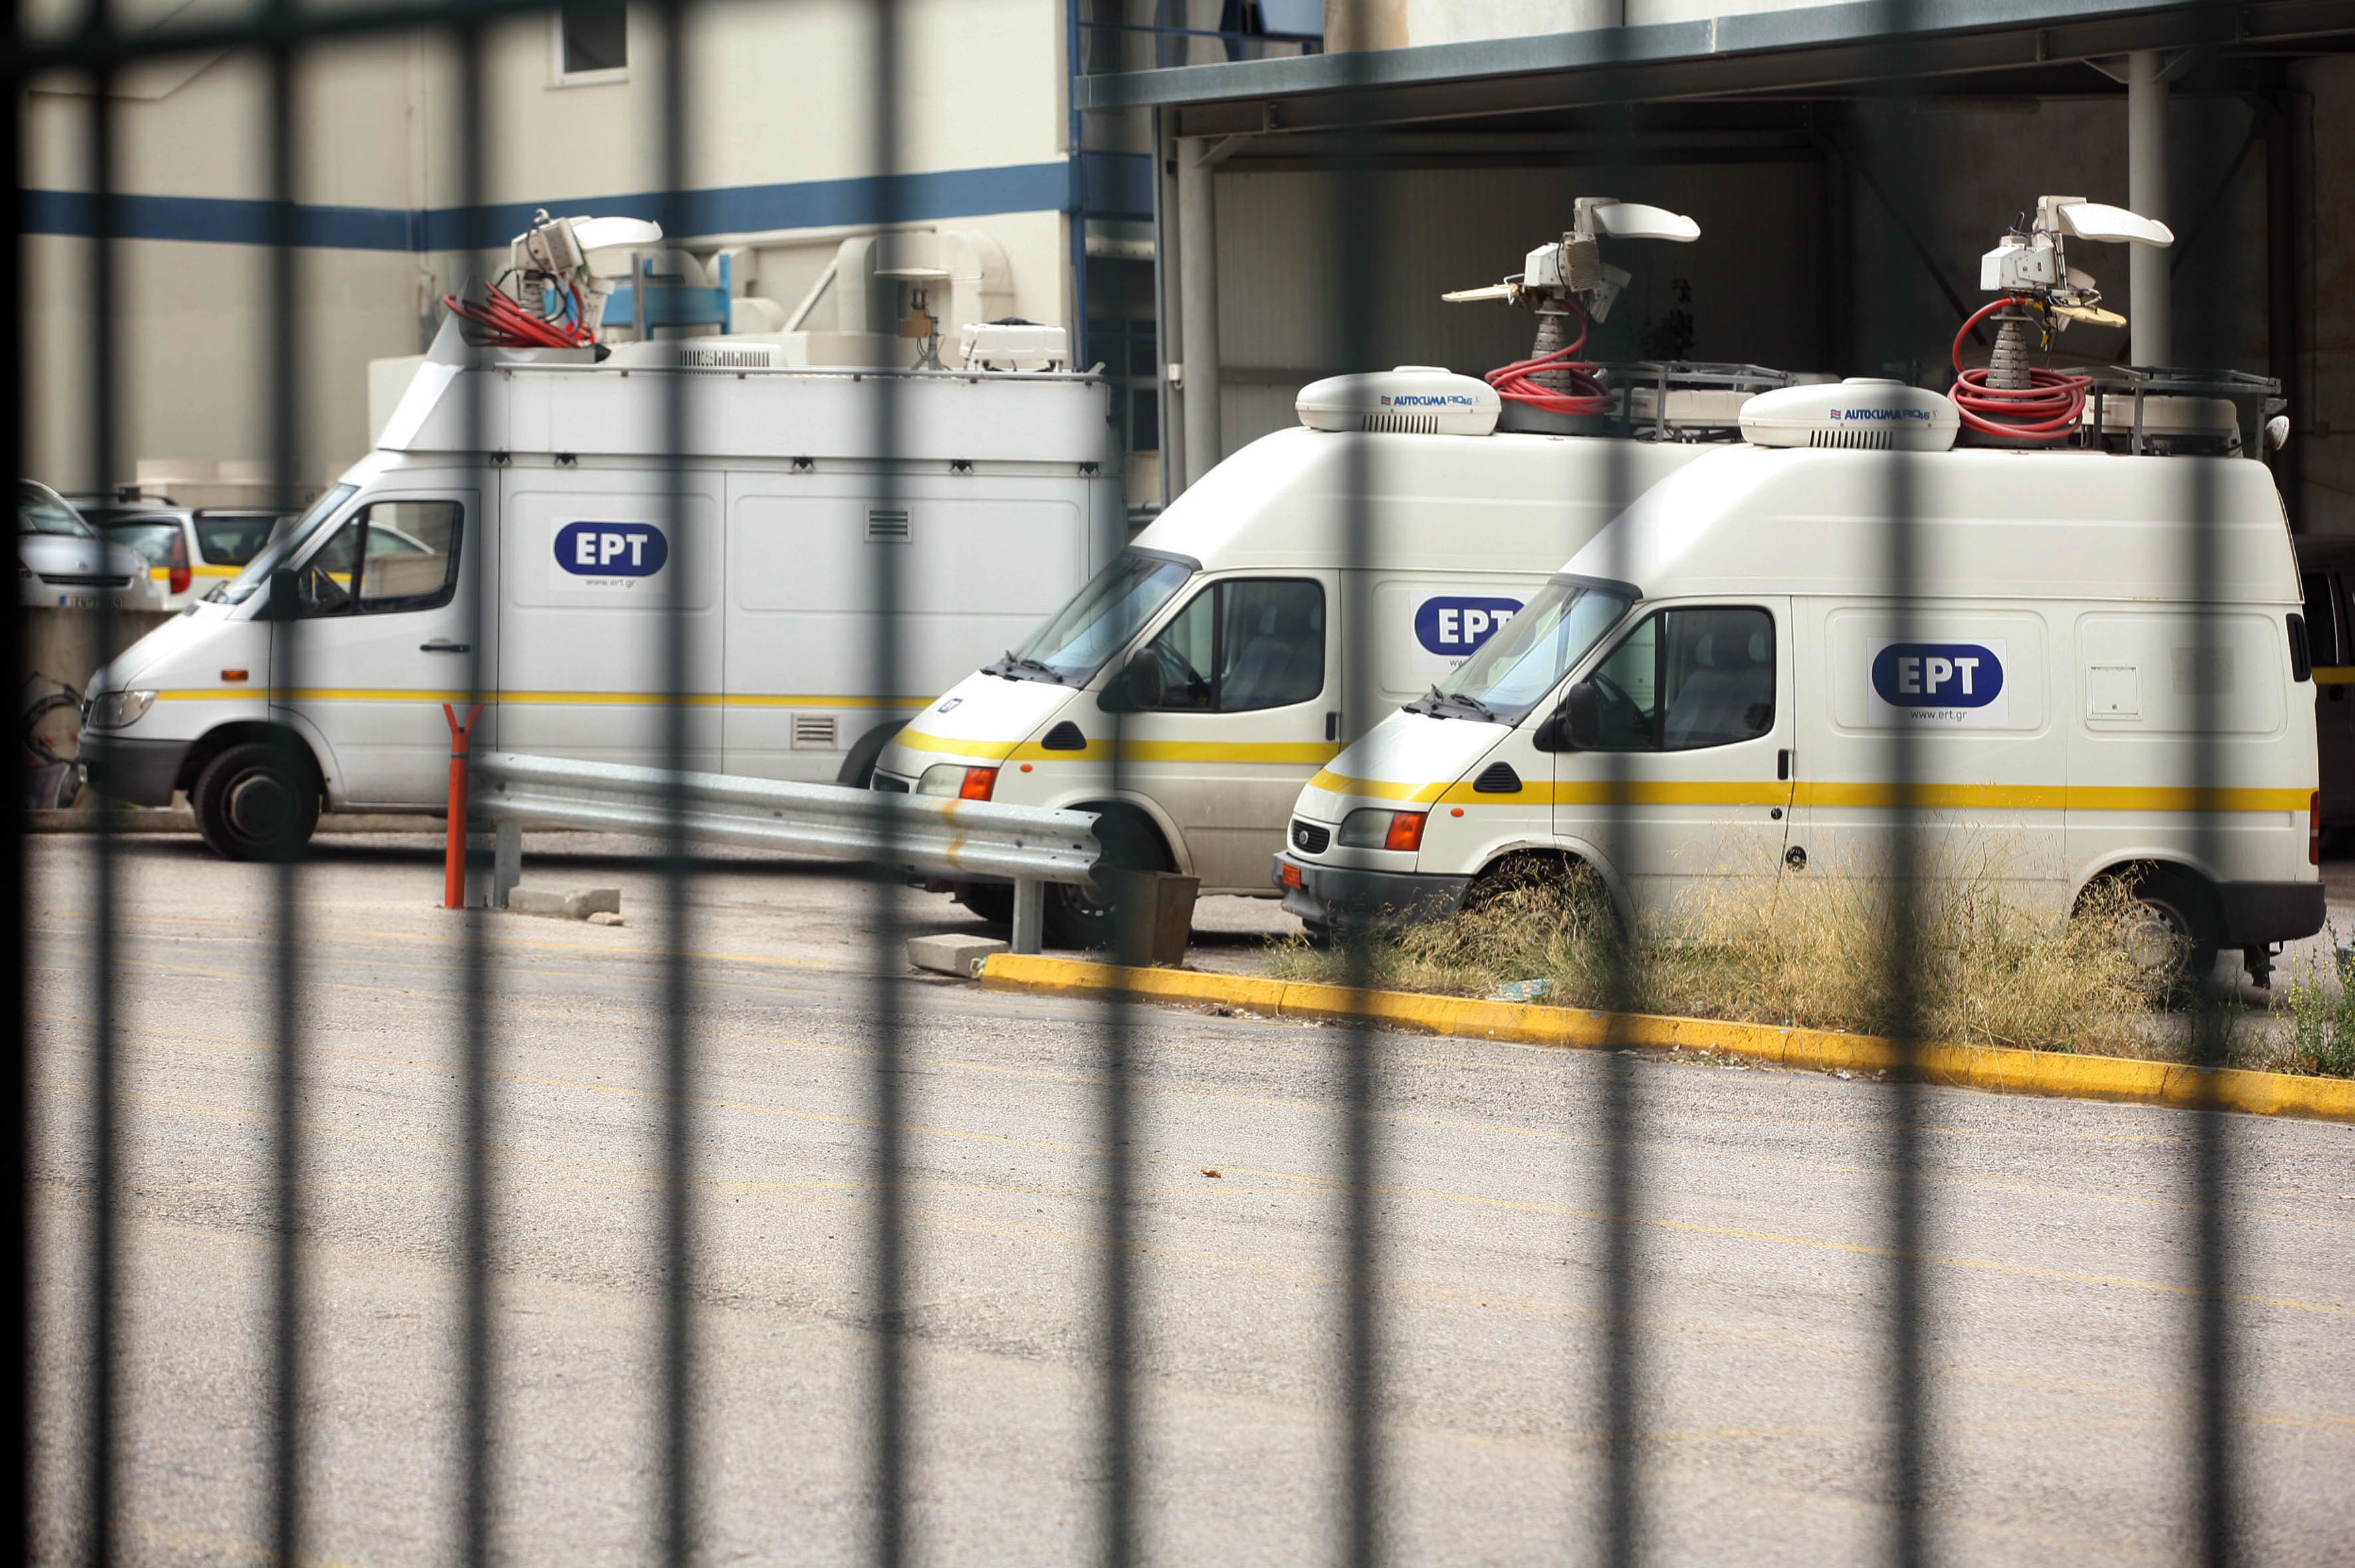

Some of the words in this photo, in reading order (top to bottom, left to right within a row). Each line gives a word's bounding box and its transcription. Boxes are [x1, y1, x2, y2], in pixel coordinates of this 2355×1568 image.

[1393, 395, 1446, 406] AUTOCLIMA
[1845, 409, 1902, 420] AUTOCLIMA
[585, 578, 635, 588] www.ert.gr
[1910, 709, 1967, 722] www.ert.gr
